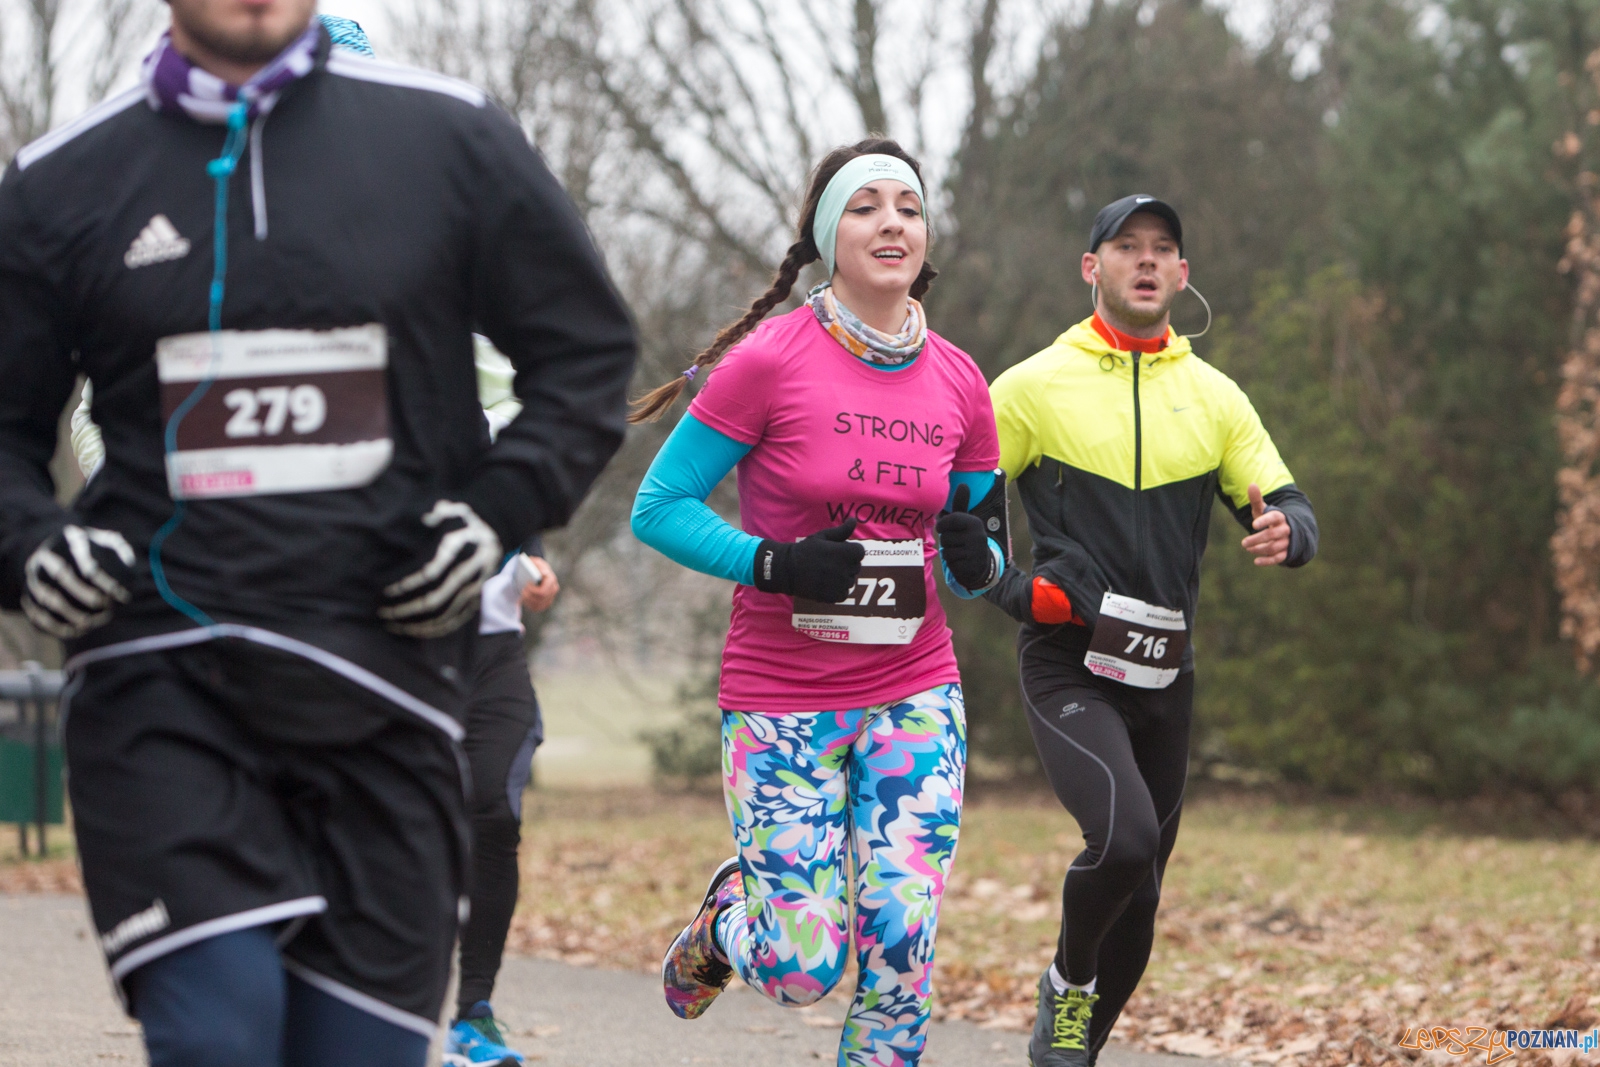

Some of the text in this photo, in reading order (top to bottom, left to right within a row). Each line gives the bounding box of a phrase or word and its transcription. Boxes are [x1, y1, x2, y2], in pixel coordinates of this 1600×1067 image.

[224, 383, 327, 438] 279
[834, 412, 944, 447] STRONG
[848, 458, 927, 488] & FIT
[826, 502, 934, 529] WOMEN
[1124, 631, 1168, 659] 716
